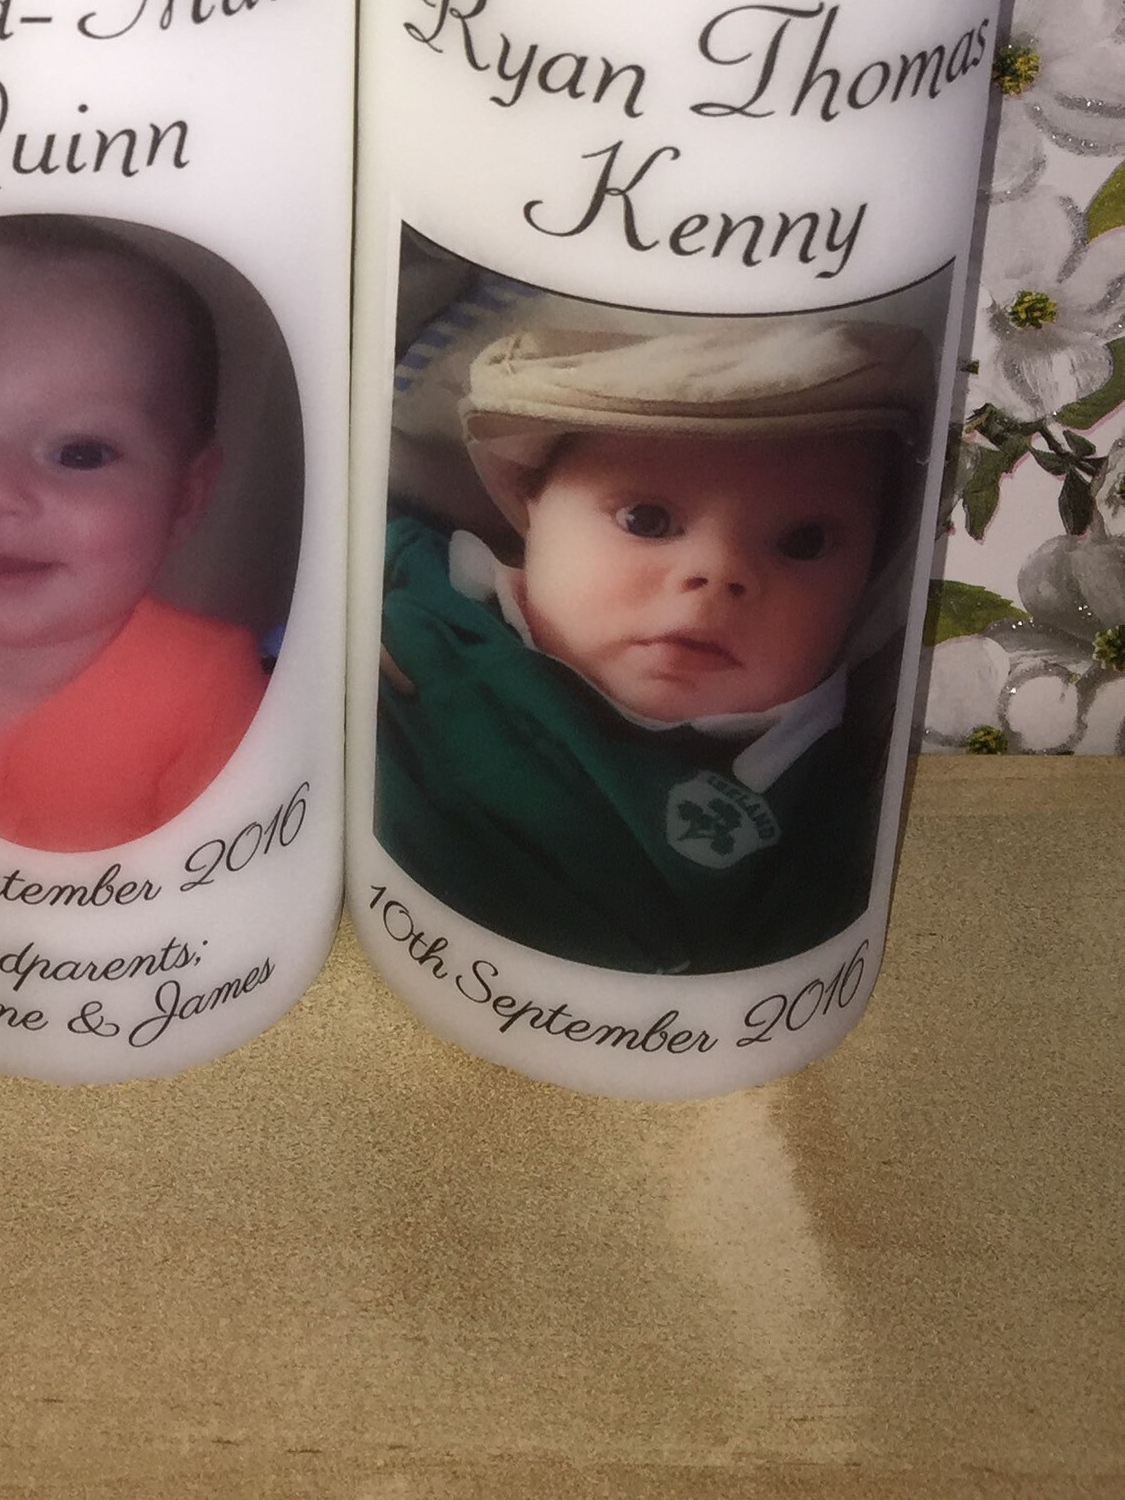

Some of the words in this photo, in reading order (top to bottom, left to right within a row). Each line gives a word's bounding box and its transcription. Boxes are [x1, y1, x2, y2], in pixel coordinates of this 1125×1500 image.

[689, 2, 990, 123] Thomas
[523, 140, 868, 279] Kenny
[180, 781, 310, 892] 2016
[67, 1000, 120, 1037] &
[128, 957, 275, 1047] James
[370, 885, 448, 979] 10th
[455, 959, 719, 1055] September
[736, 939, 869, 1048] 2016
